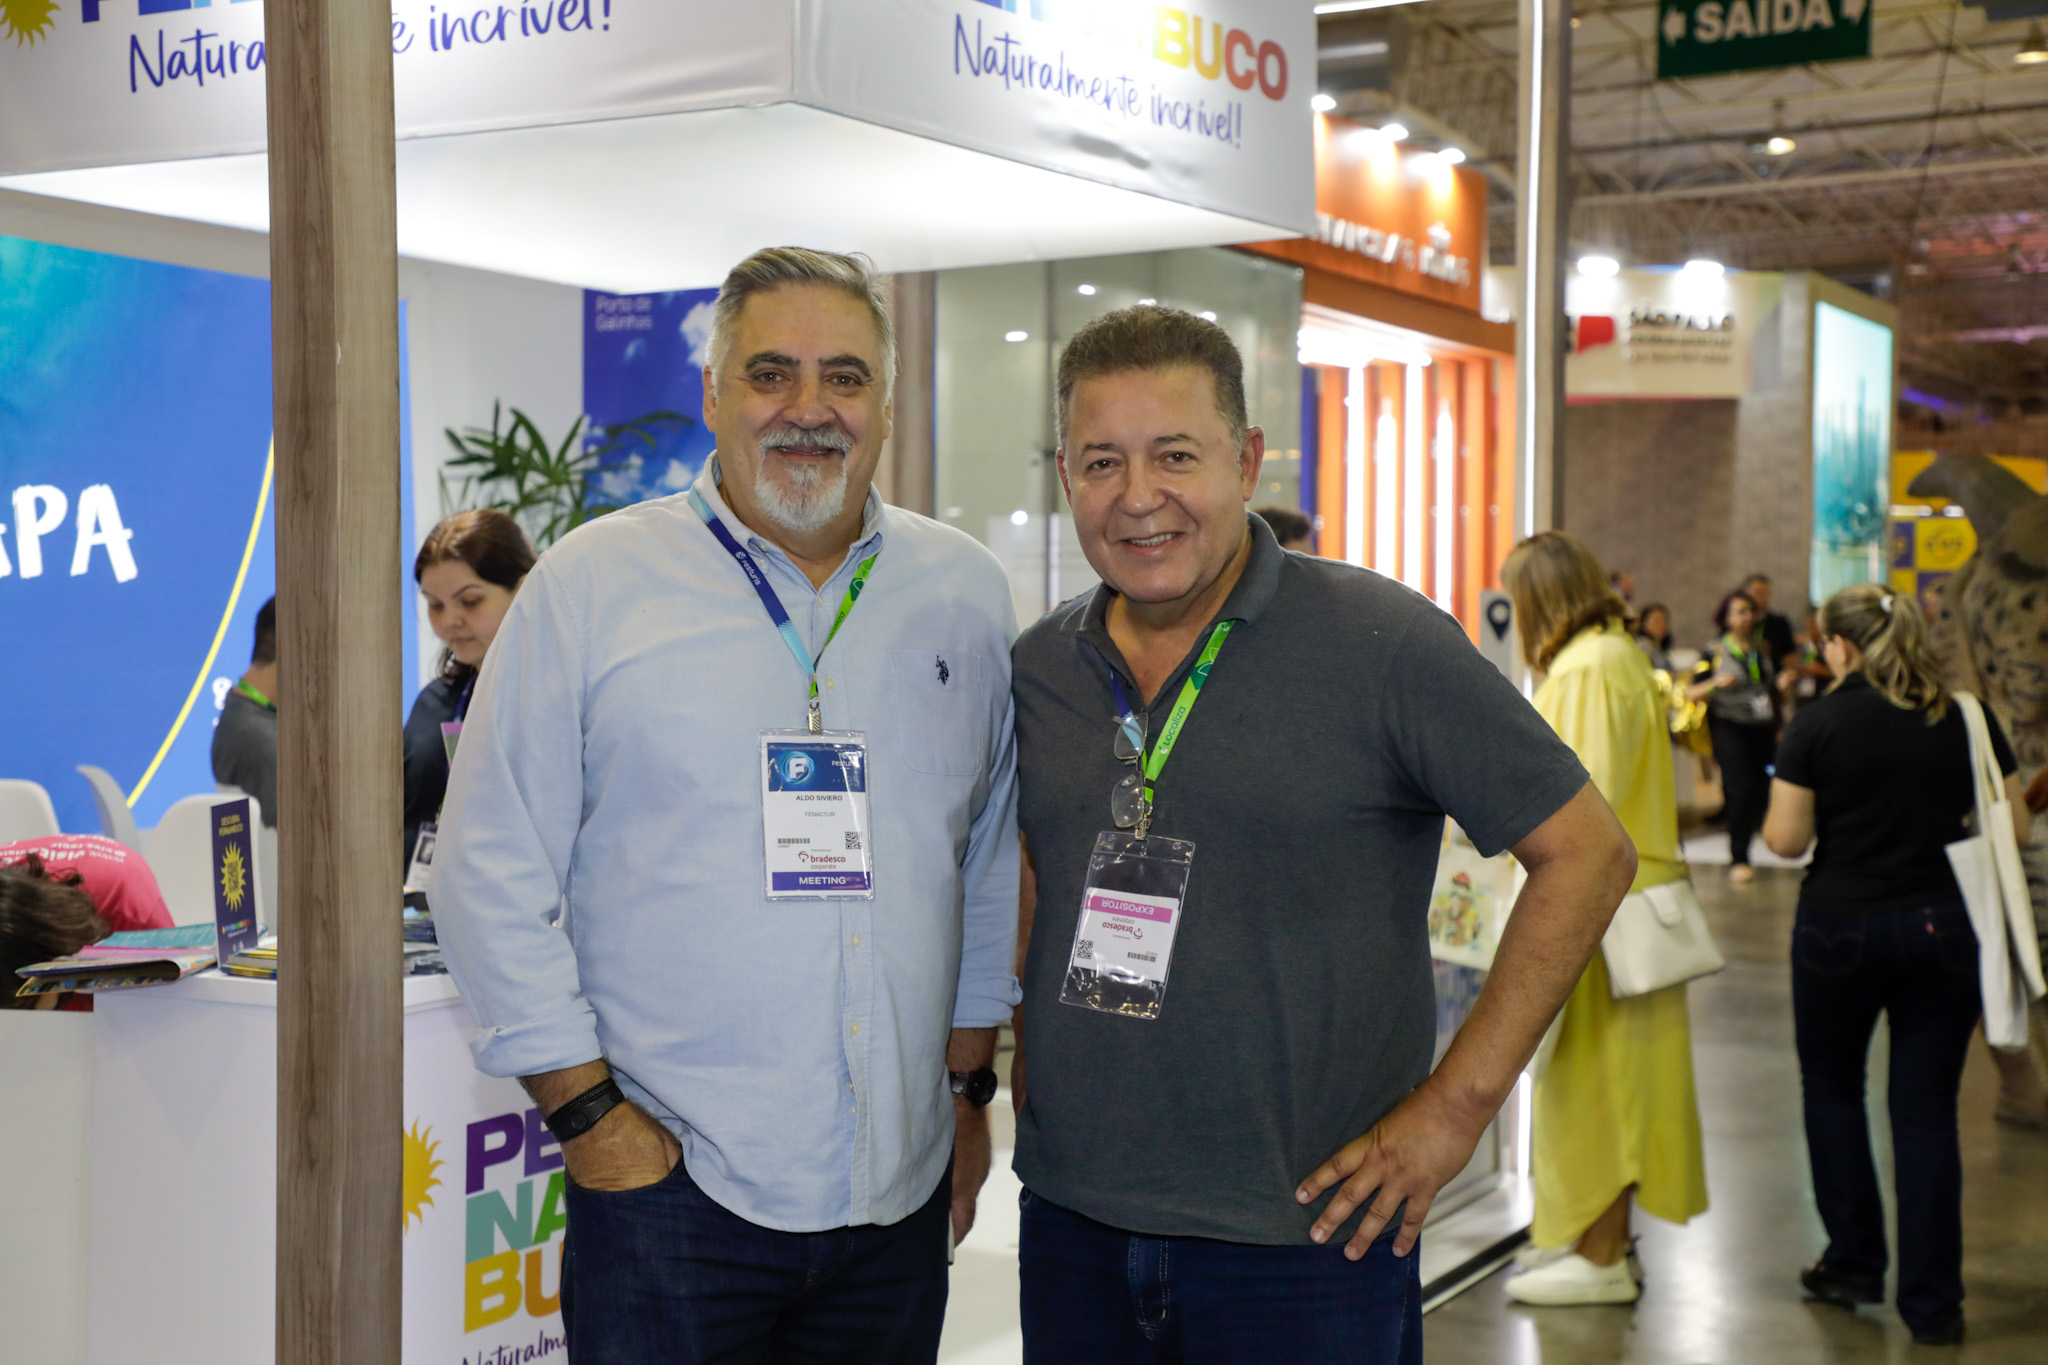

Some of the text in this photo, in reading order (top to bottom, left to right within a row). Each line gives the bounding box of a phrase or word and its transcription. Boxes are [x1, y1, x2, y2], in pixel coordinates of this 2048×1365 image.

[954, 12, 1242, 149] Naturalmente incrível!
[1163, 705, 1187, 746] Localiza
[810, 854, 846, 863] bradesco
[798, 876, 847, 885] MEETING
[1101, 899, 1154, 916] EXPOSITOR
[1102, 921, 1133, 934] bradesco
